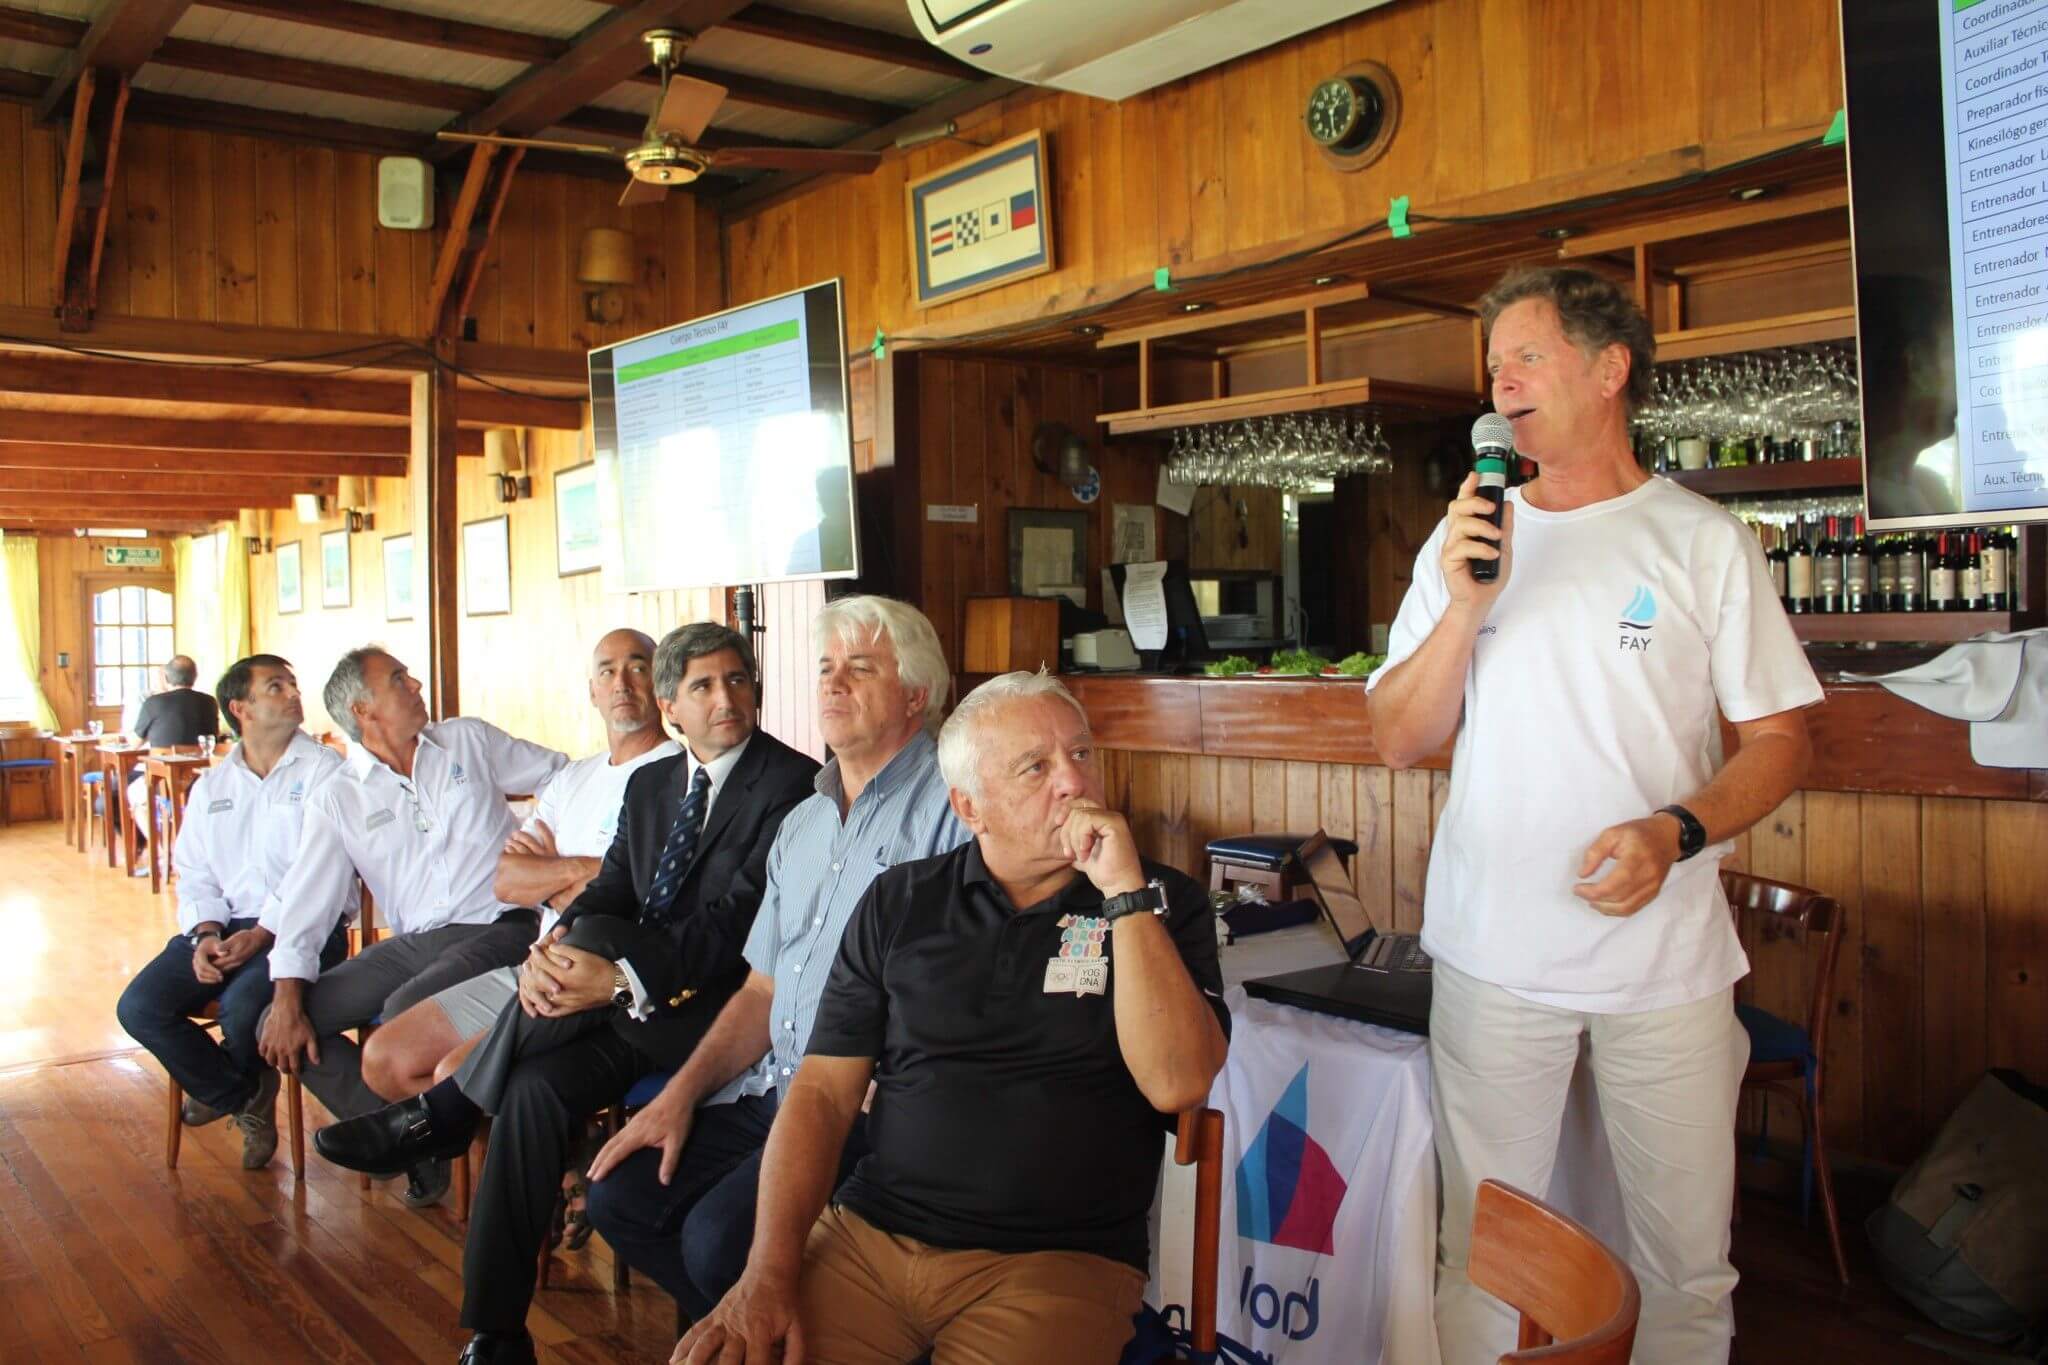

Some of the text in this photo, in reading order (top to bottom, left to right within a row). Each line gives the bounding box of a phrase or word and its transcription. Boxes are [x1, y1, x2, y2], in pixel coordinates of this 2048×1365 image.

[1964, 20, 2048, 62] Auxiliar Técnic
[1965, 55, 2039, 91] Coordinador
[1967, 91, 2033, 122] Preparador
[1968, 119, 2028, 152] Kinesilógo
[1969, 152, 2035, 182] Entrenador
[1971, 184, 2037, 213] Entrenador
[1972, 214, 2048, 242] Entrenadores
[1973, 251, 2040, 275] Entrenador
[1975, 283, 2041, 308] Entrenador
[1977, 315, 2042, 338] Entrenador
[1983, 473, 2009, 486] Aux.
[1619, 635, 1653, 652] FAY
[1079, 977, 1100, 987] DNA
[1082, 968, 1101, 977] YOG
